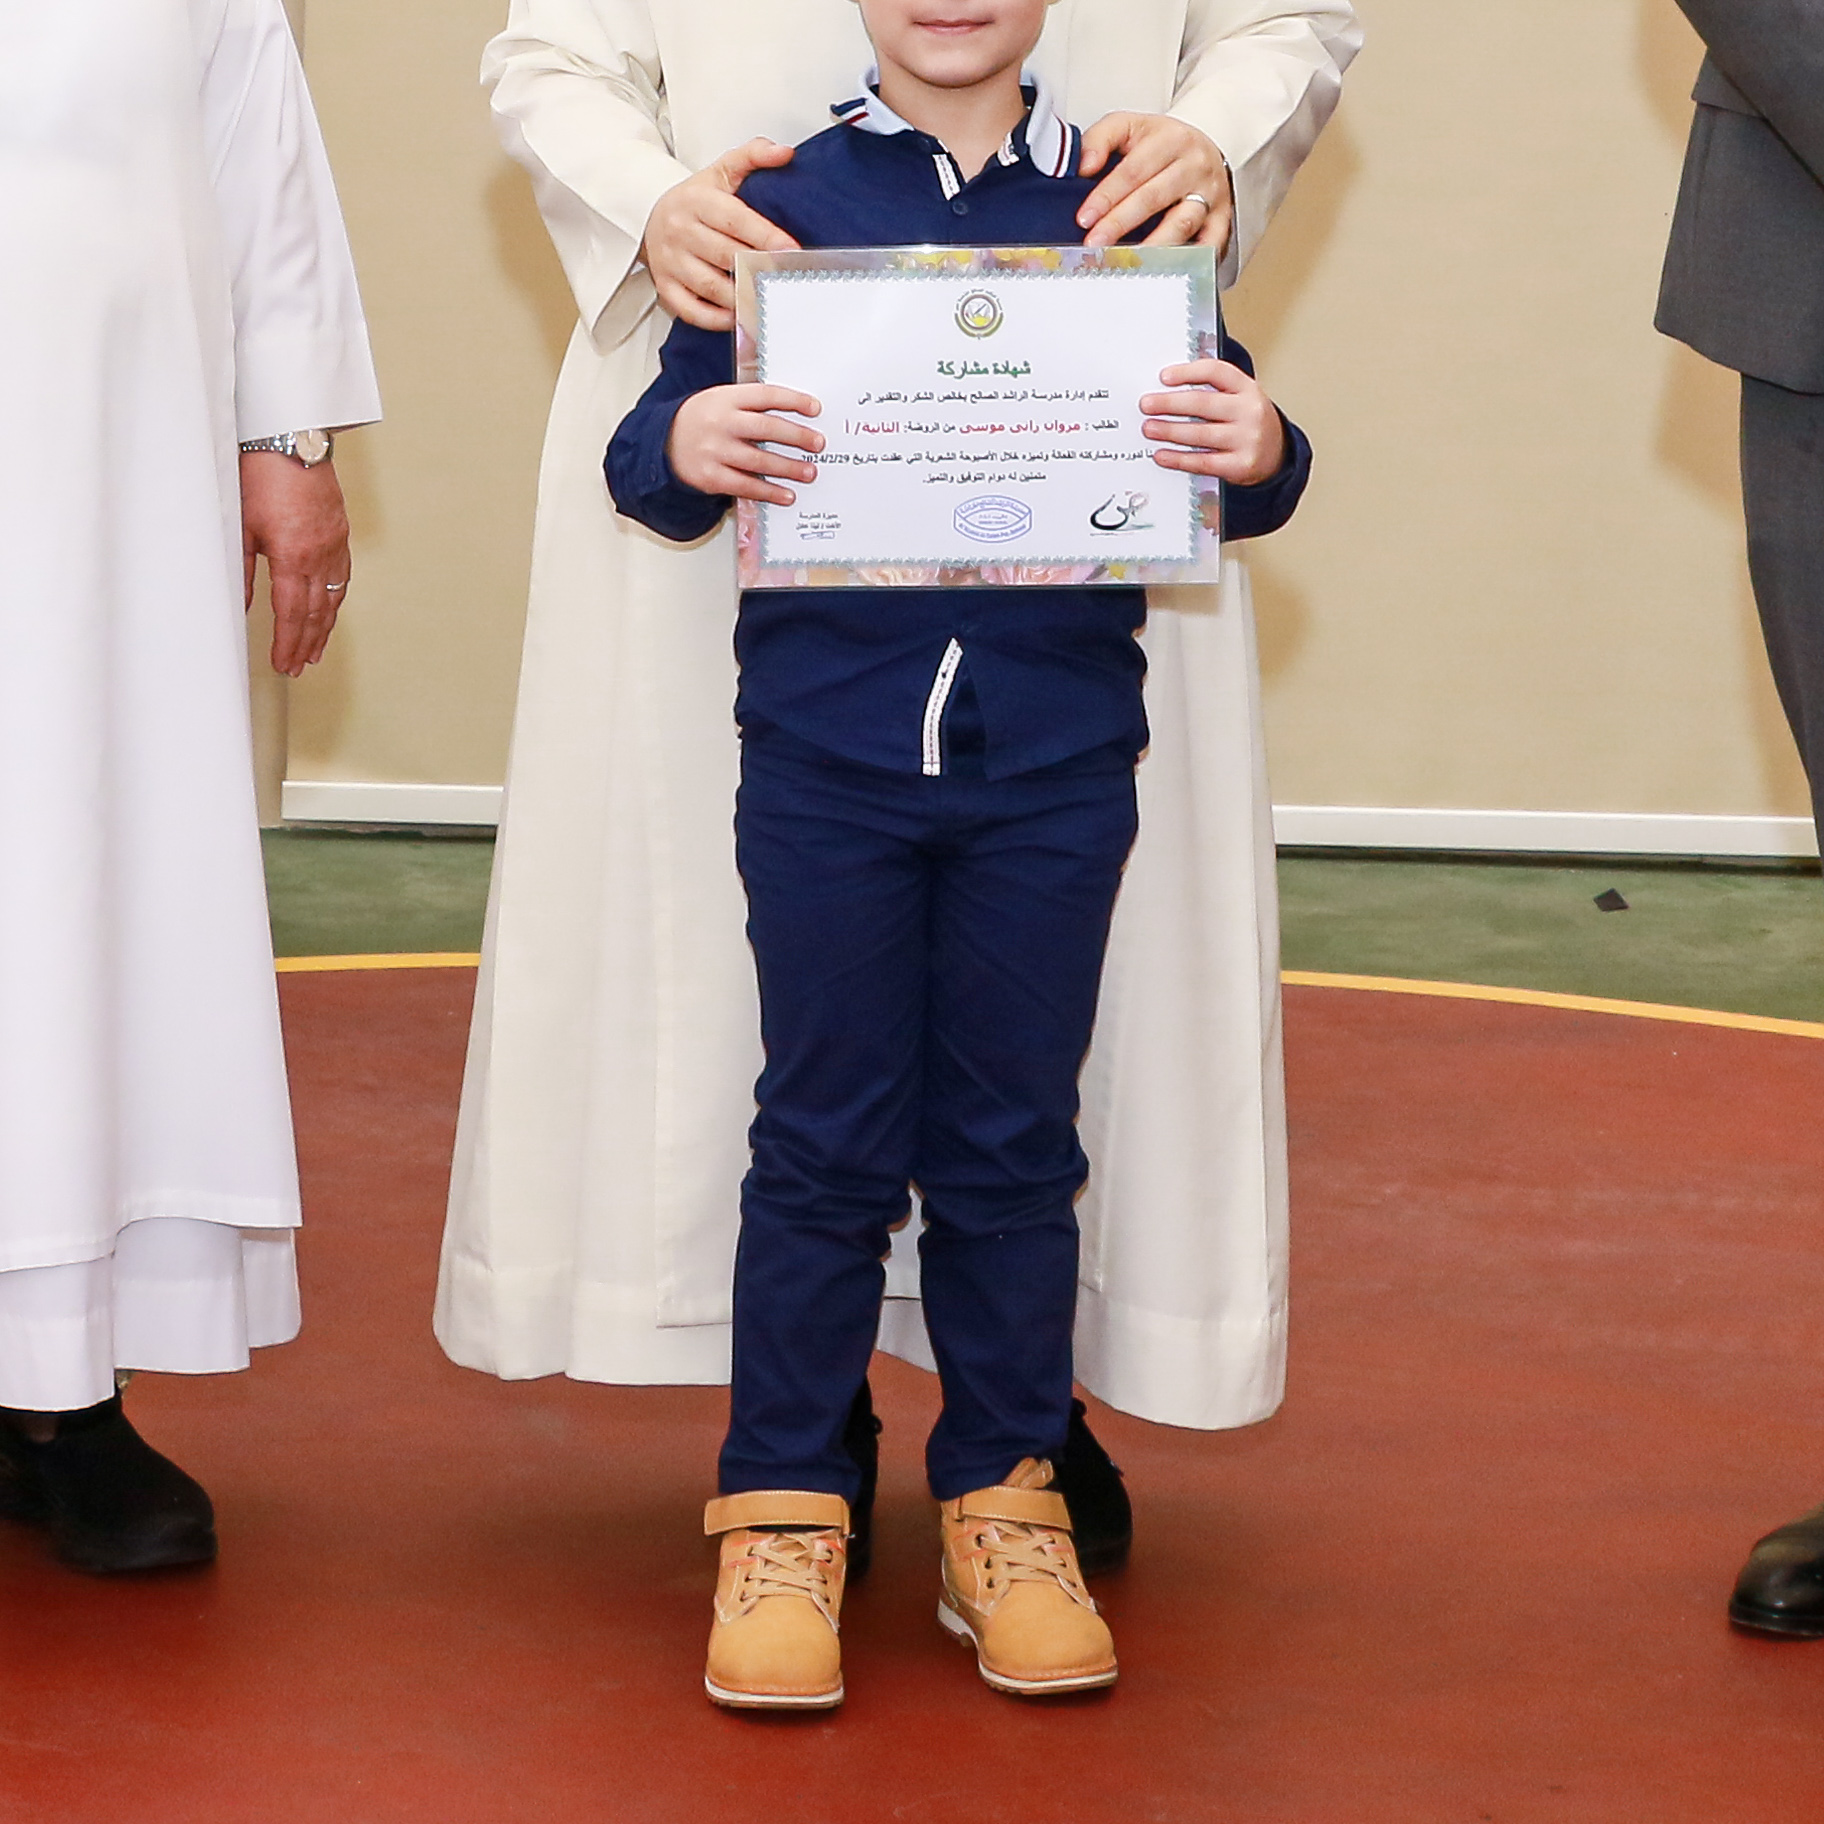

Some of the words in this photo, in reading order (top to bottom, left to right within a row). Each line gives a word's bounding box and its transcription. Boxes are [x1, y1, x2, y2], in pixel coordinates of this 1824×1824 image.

[937, 360, 989, 379] مشاركة
[993, 361, 1031, 377] شهادة
[970, 390, 998, 402] الصالح
[1002, 390, 1028, 401] الراشد
[1031, 390, 1063, 400] مدرسة
